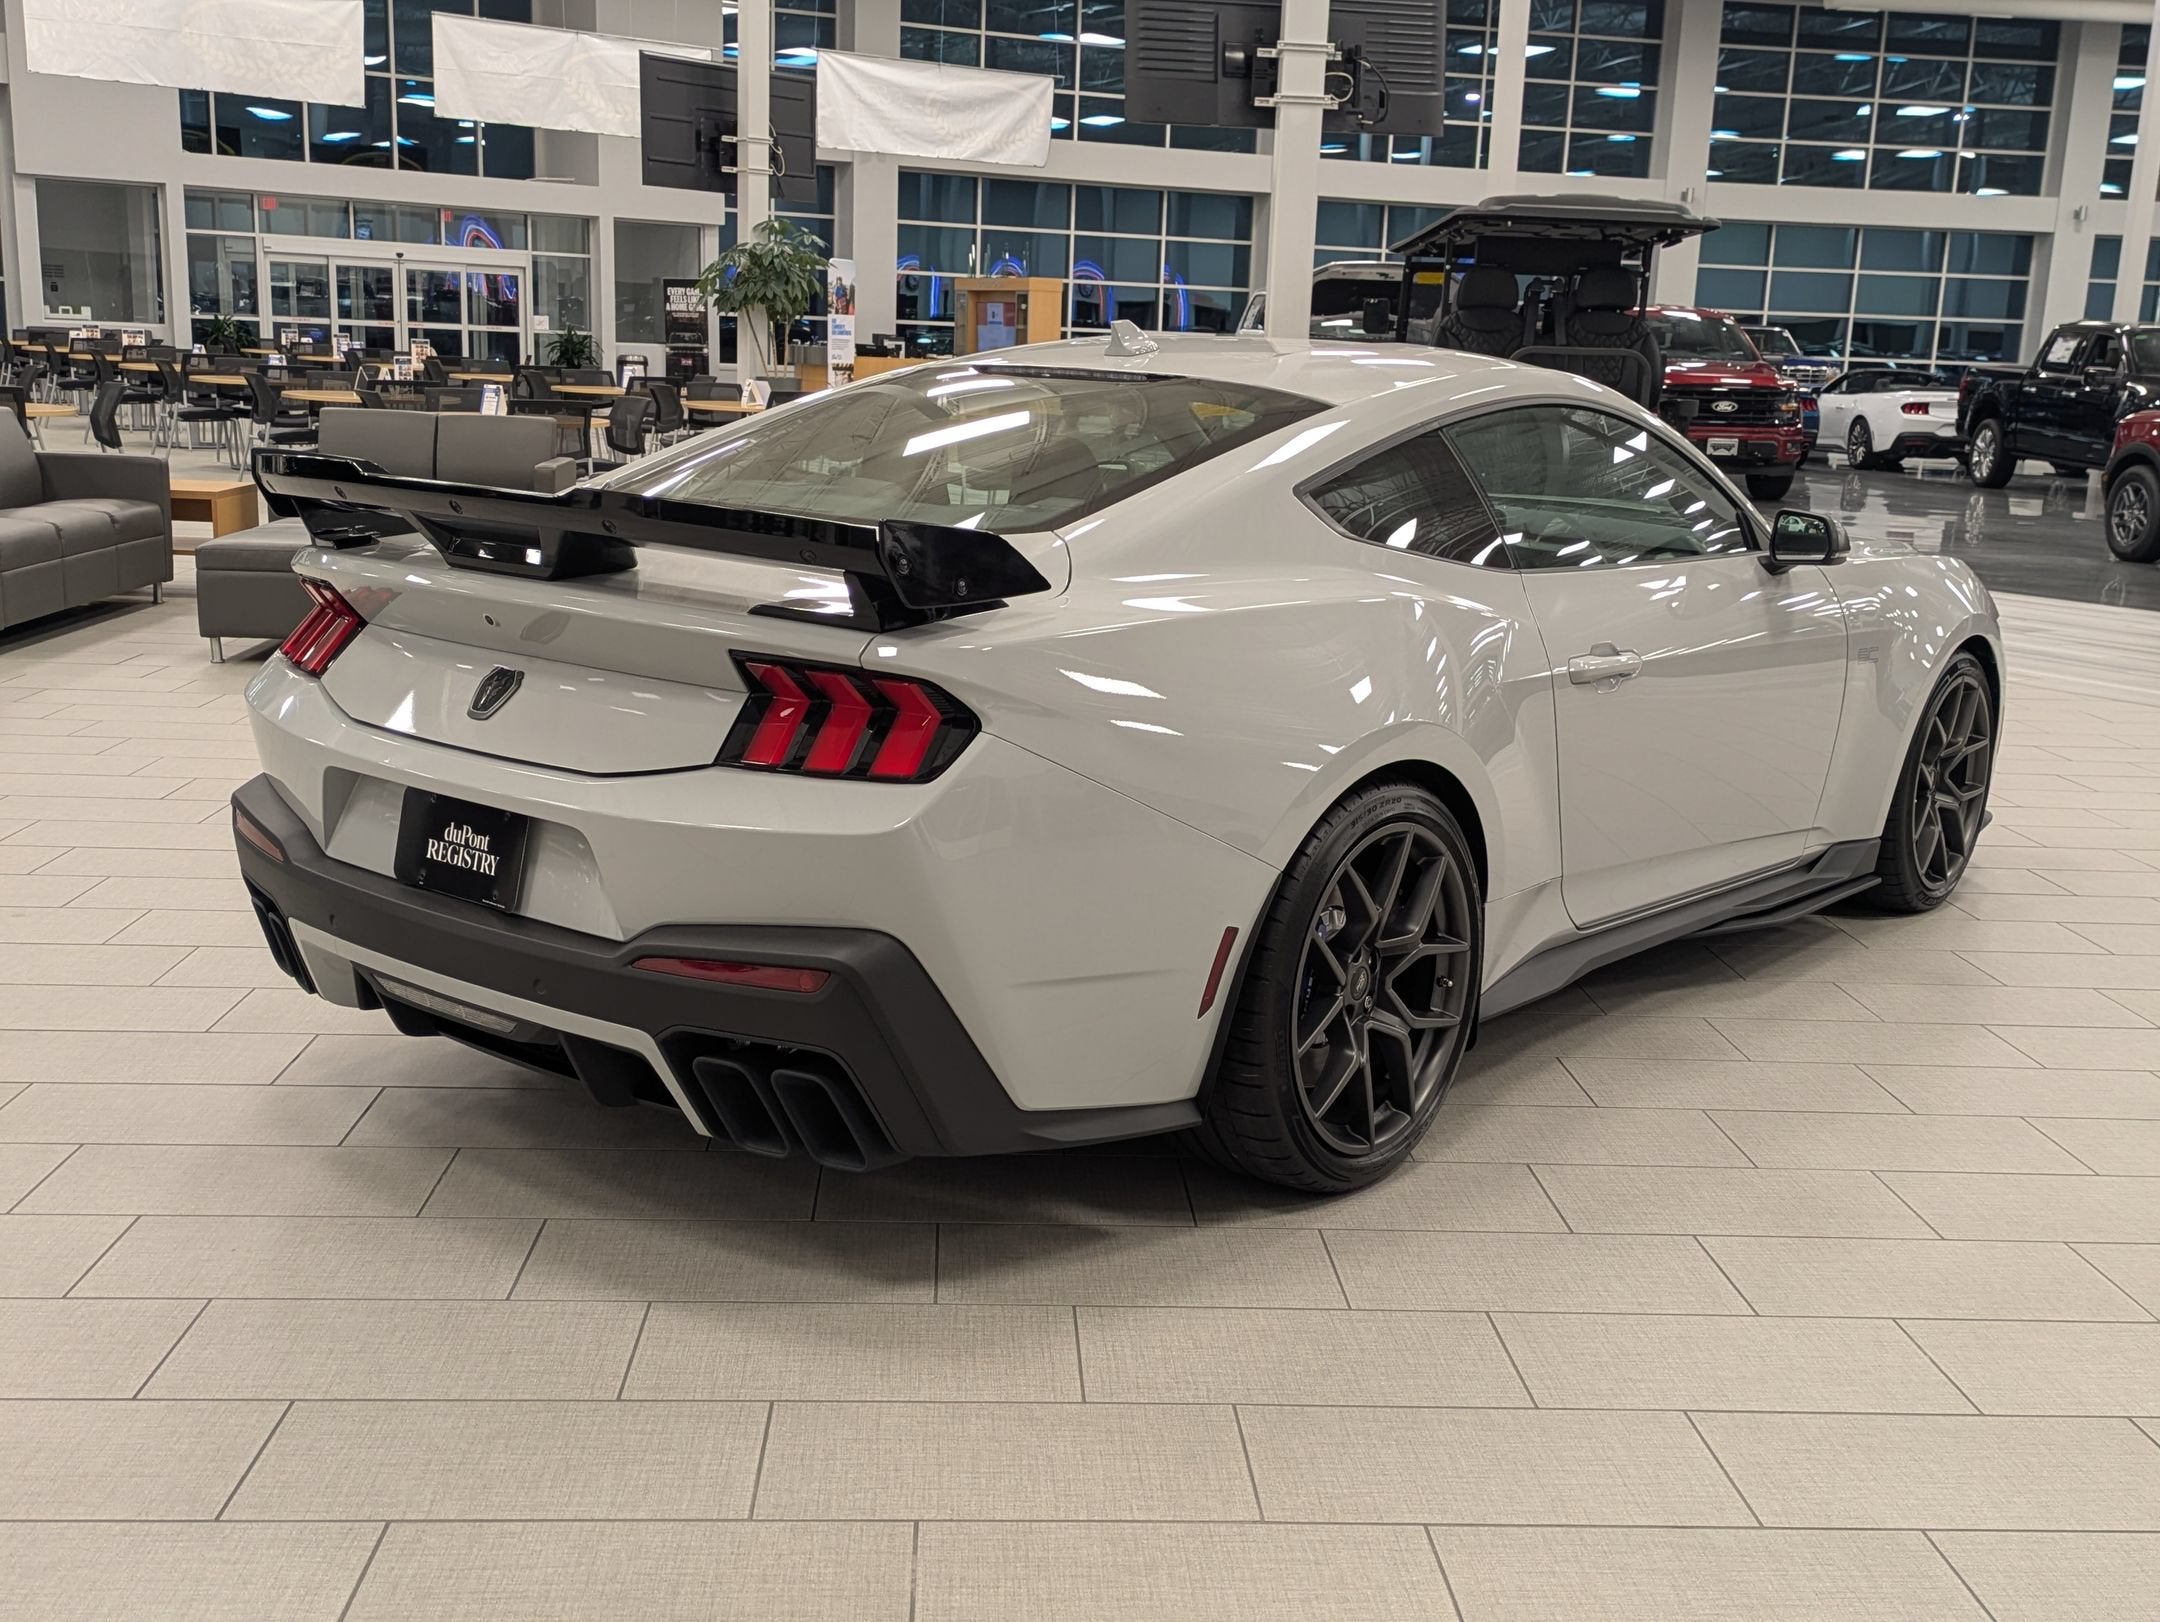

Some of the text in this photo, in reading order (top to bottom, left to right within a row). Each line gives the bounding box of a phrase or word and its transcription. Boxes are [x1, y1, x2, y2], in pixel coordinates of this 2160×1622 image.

[667, 287, 685, 295] EVERY
[670, 295, 687, 303] FEELS
[666, 302, 670, 311] A
[444, 822, 490, 851] duPont
[426, 838, 500, 876] REGISTRY
